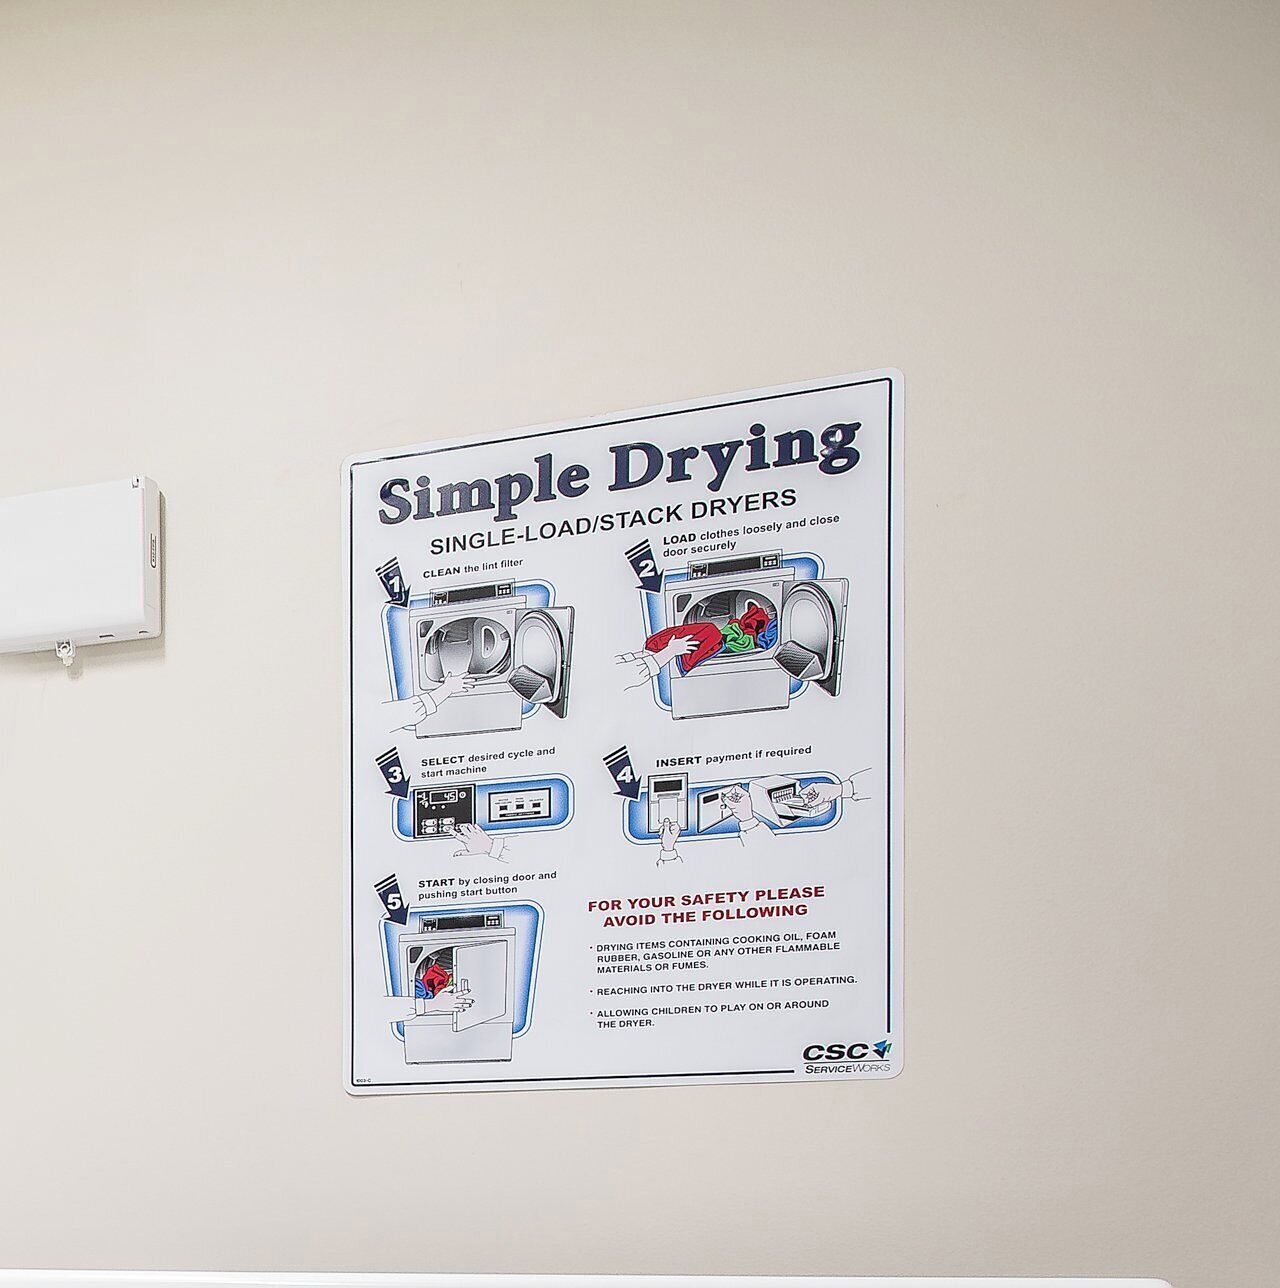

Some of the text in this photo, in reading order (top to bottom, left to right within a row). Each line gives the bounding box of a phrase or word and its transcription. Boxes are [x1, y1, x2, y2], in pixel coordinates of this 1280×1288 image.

[378, 421, 862, 525] Simple Drying
[430, 488, 796, 555] SINGLE-LOAD/STACK DRYERS
[663, 515, 839, 545] LOAD clothes loosely and close
[662, 539, 736, 557] door securely
[422, 559, 523, 578] CLEAN the lint filter
[656, 745, 811, 767] INSERT payment if required
[588, 885, 825, 912] FOR YOUR SAFETY PLEASE
[602, 904, 807, 927] AVOID THE FOLLOWING
[597, 975, 857, 995] REACHING INTO THE DRYER WHILE IT IS OPERATING.
[803, 1043, 869, 1061] CSC
